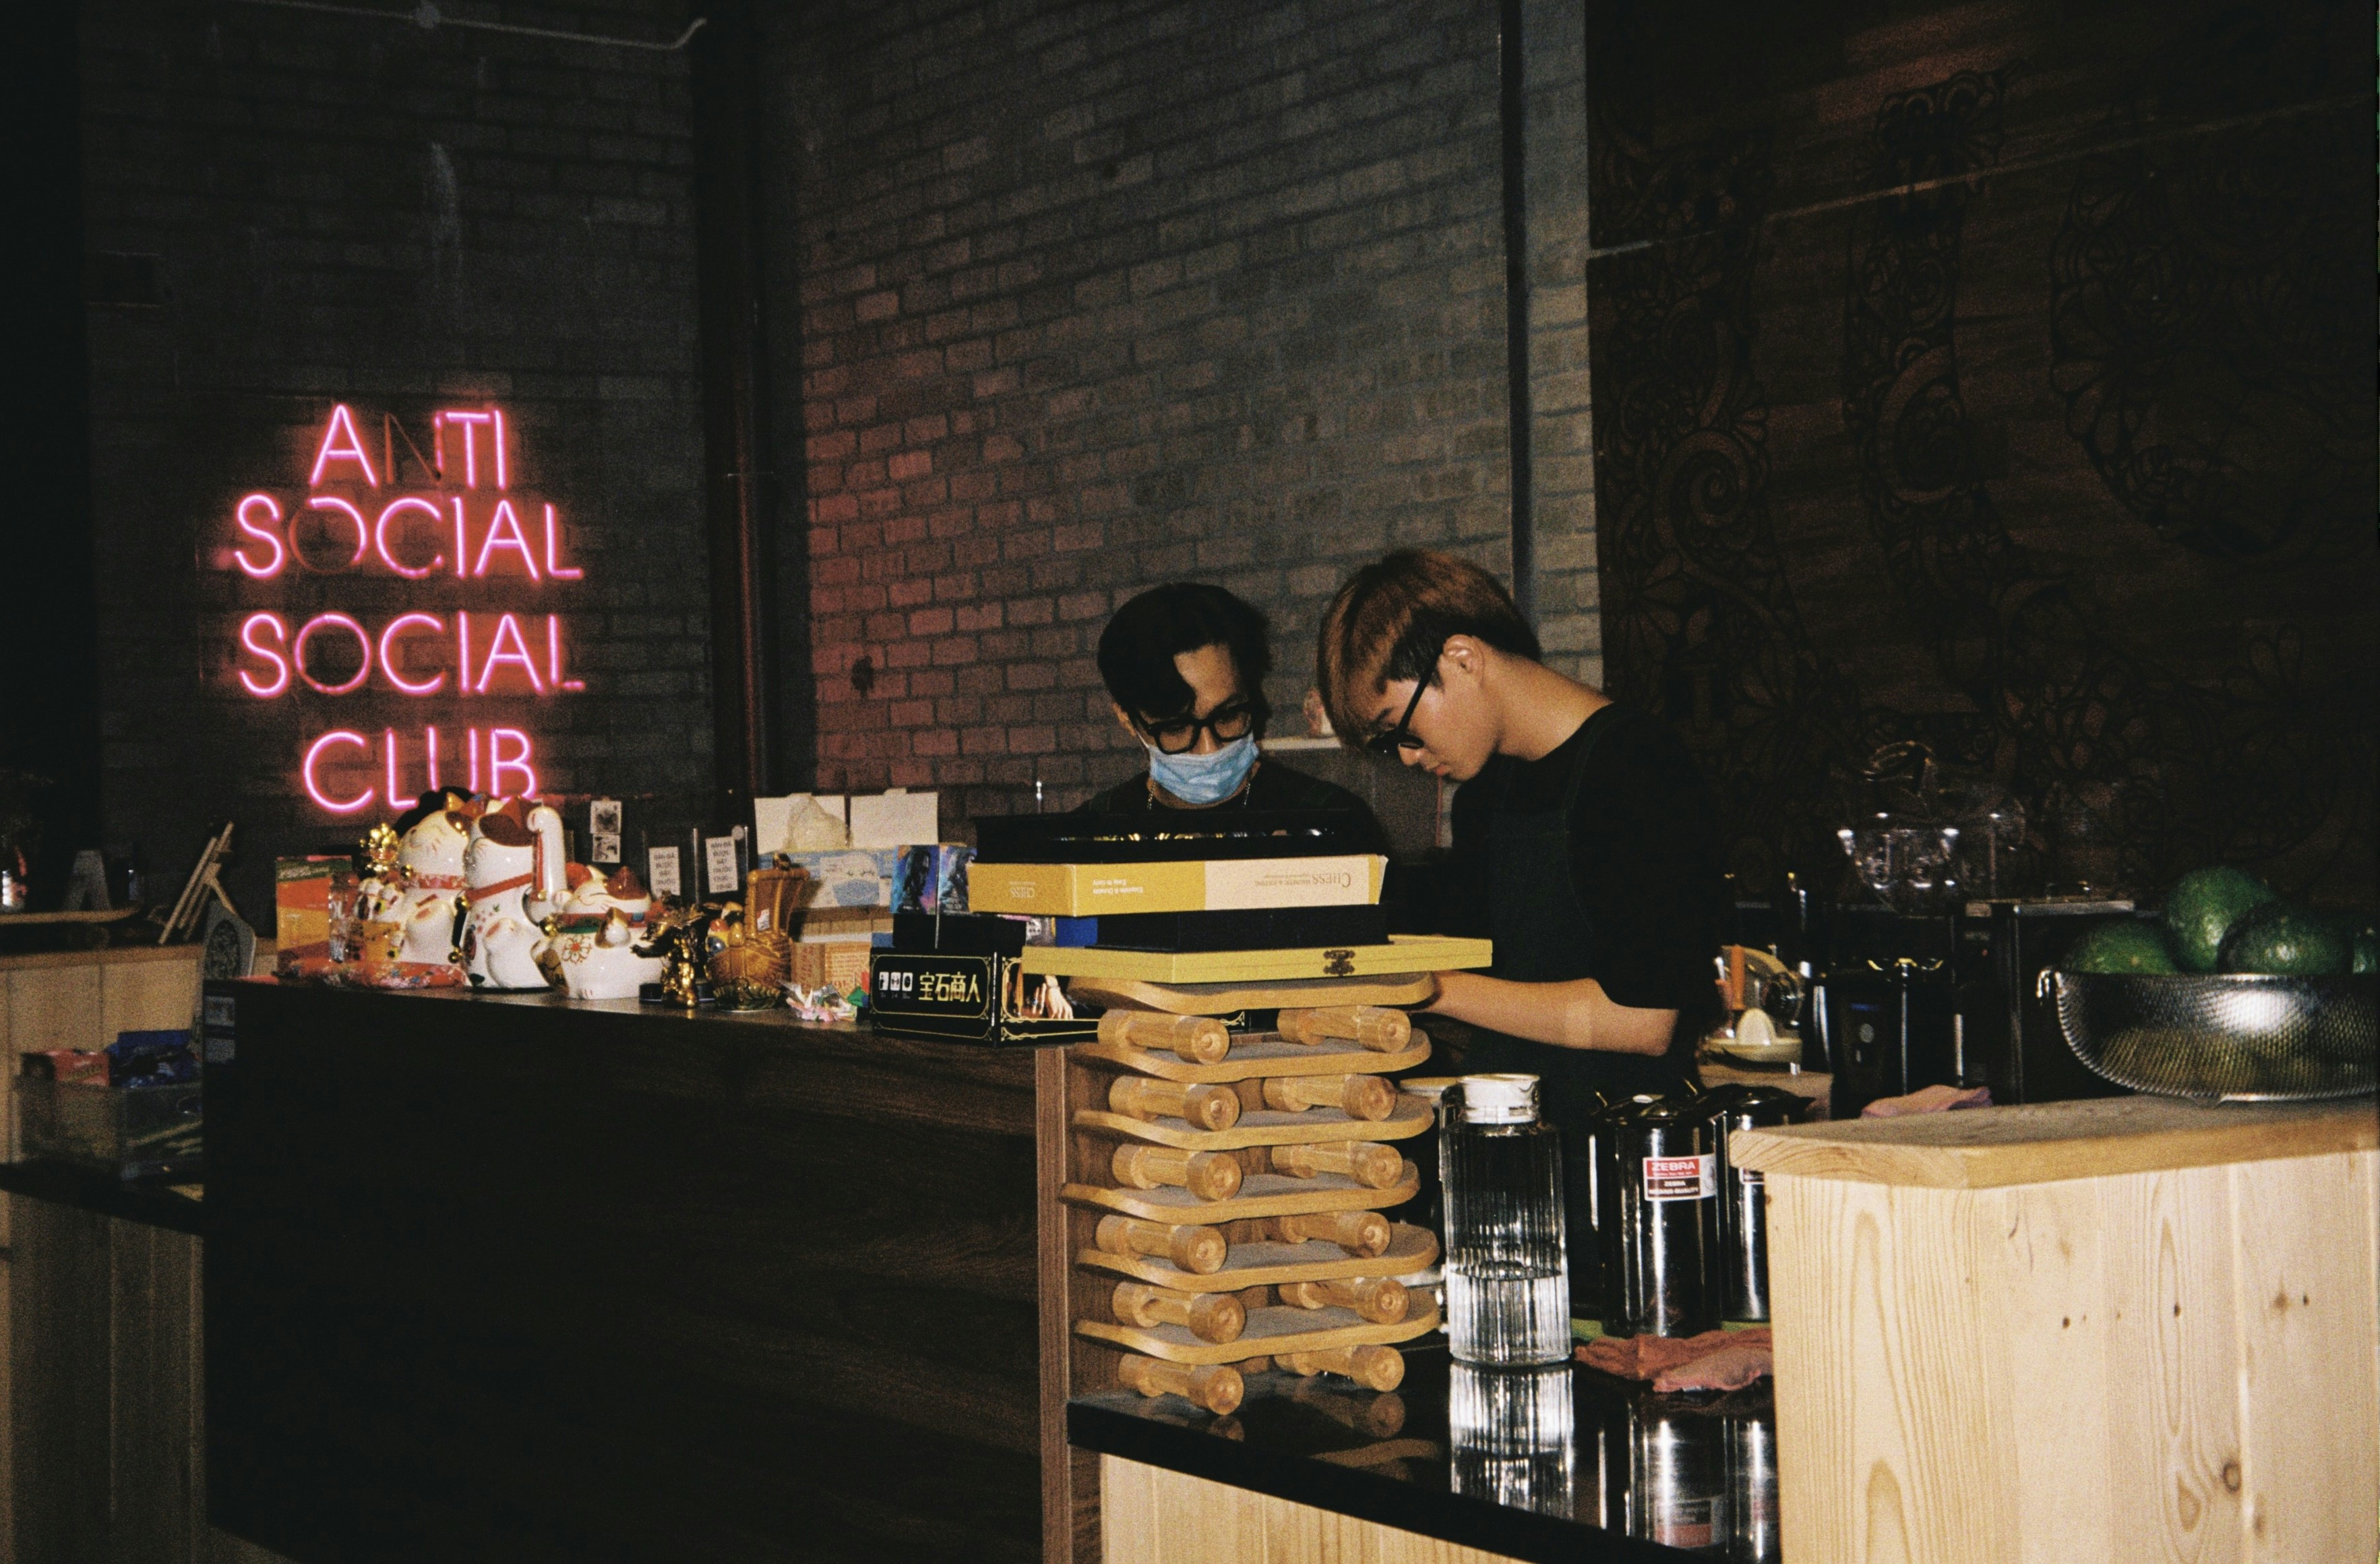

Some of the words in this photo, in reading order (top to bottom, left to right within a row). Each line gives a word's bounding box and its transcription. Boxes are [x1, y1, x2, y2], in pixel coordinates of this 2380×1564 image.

[309, 404, 507, 489] ANTI
[235, 494, 584, 581] SOCIAL
[239, 611, 586, 696] SOCIAL
[303, 727, 537, 813] CLUB
[918, 971, 981, 1003] 宝石商人
[1651, 1160, 1696, 1172] ZEBRA
